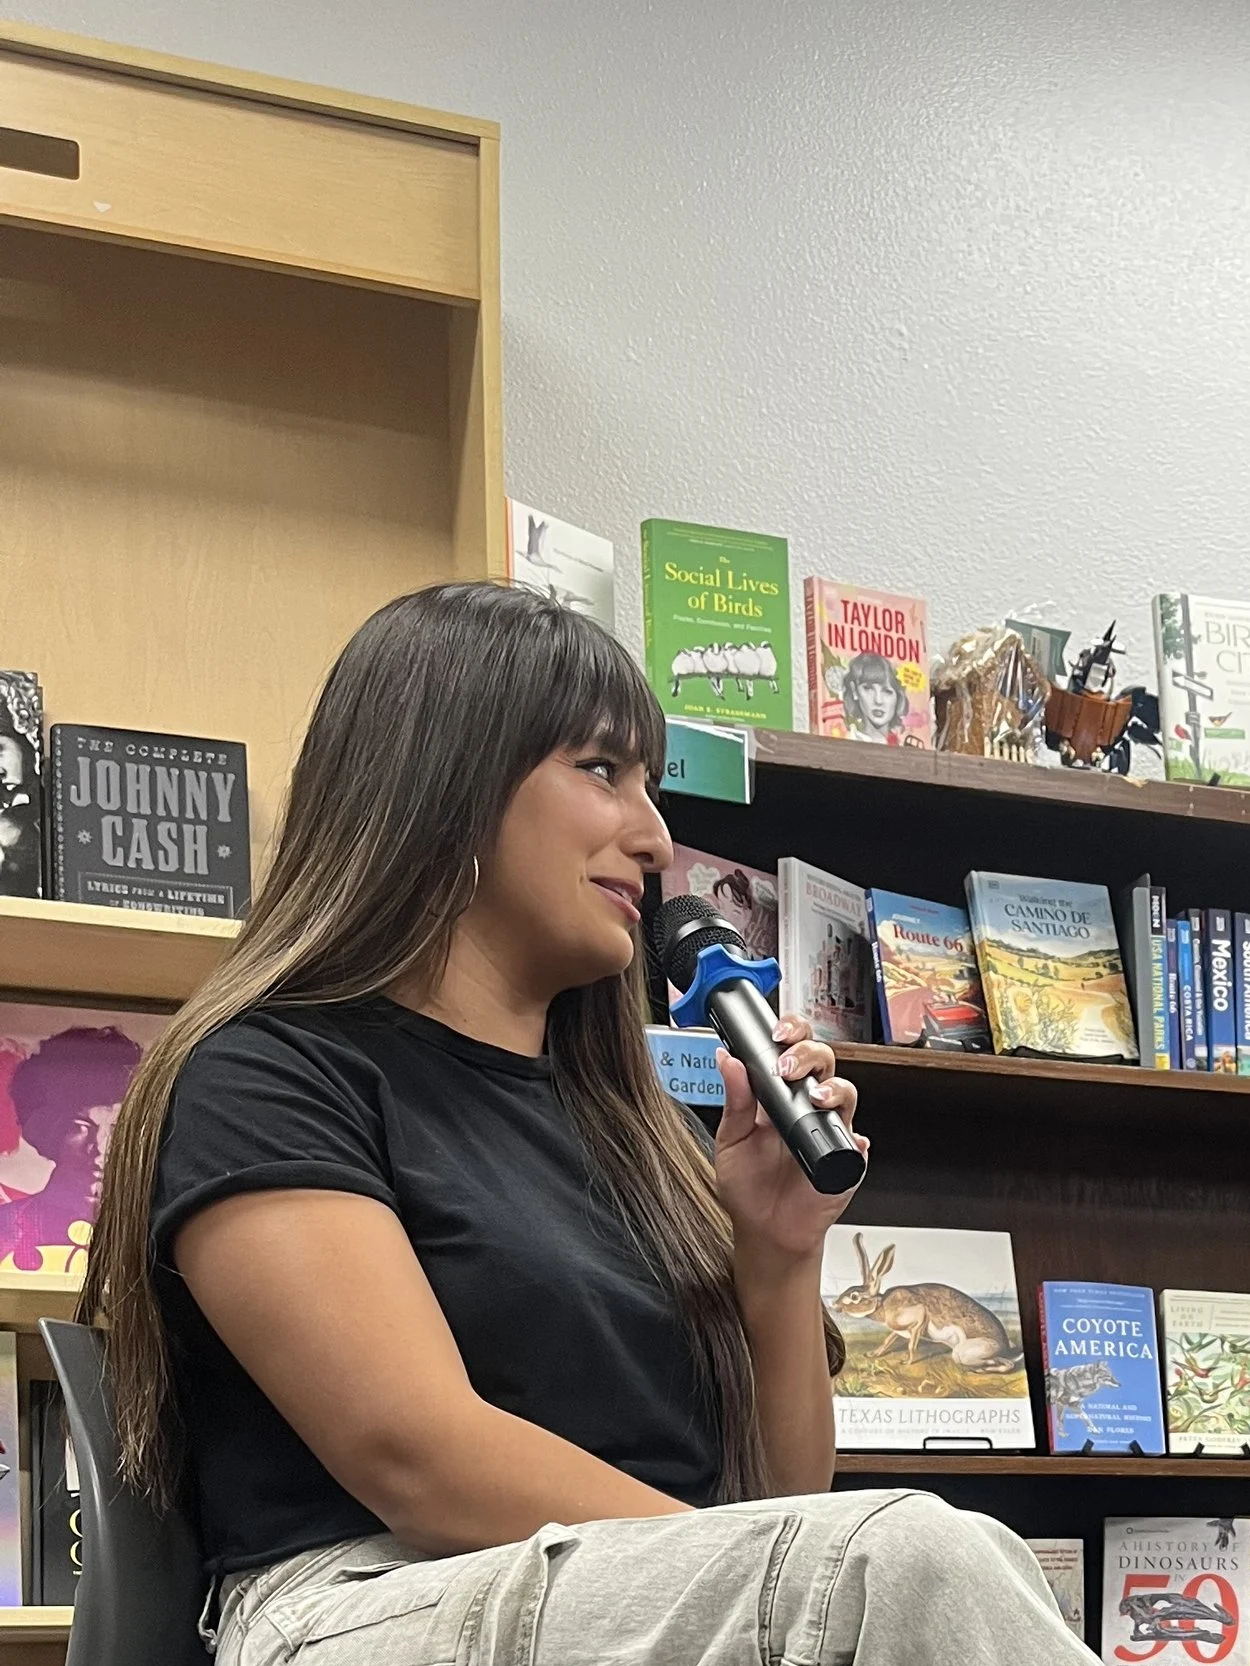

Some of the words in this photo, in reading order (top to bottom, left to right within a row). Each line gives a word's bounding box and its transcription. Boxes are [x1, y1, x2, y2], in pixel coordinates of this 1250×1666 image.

[664, 562, 721, 588] Social
[727, 571, 779, 597] Lives
[688, 593, 709, 611] of
[713, 594, 763, 618] Birds
[841, 600, 906, 635] TAYLOR
[828, 622, 847, 650] IN
[849, 627, 920, 663] LONDON
[77, 737, 114, 753] THE
[125, 744, 228, 765] COMPLETE
[70, 757, 236, 823] JOHNNY
[101, 815, 209, 875] CASH
[87, 880, 129, 895] LYRICS
[167, 888, 225, 905] LIFETIME
[805, 881, 862, 916] BROADWAY
[1003, 904, 1067, 924] CAMINO
[1072, 910, 1092, 926] DE
[893, 923, 941, 947] Route
[943, 934, 965, 952] 66
[1011, 919, 1091, 940] SANTIAGO
[1152, 962, 1164, 1014] NATIONAL
[1211, 939, 1233, 1012] Mexico
[1183, 984, 1193, 1017] COSTA
[1154, 1016, 1165, 1050] PARKS
[1185, 1018, 1194, 1042] RICA
[660, 1052, 674, 1068] &
[1062, 1317, 1144, 1338] COYOTE
[1054, 1338, 1154, 1360] AMERICA
[838, 1408, 893, 1424] TEXAS
[898, 1408, 1021, 1425] LITHOGRAPHS
[1087, 1403, 1120, 1411] NATURAL
[1120, 1541, 1127, 1551] A
[1130, 1541, 1209, 1552] HISTORY
[1118, 1555, 1240, 1571] DINOSAURS
[1174, 1574, 1186, 1583] IN
[1114, 1573, 1240, 1664] 50
